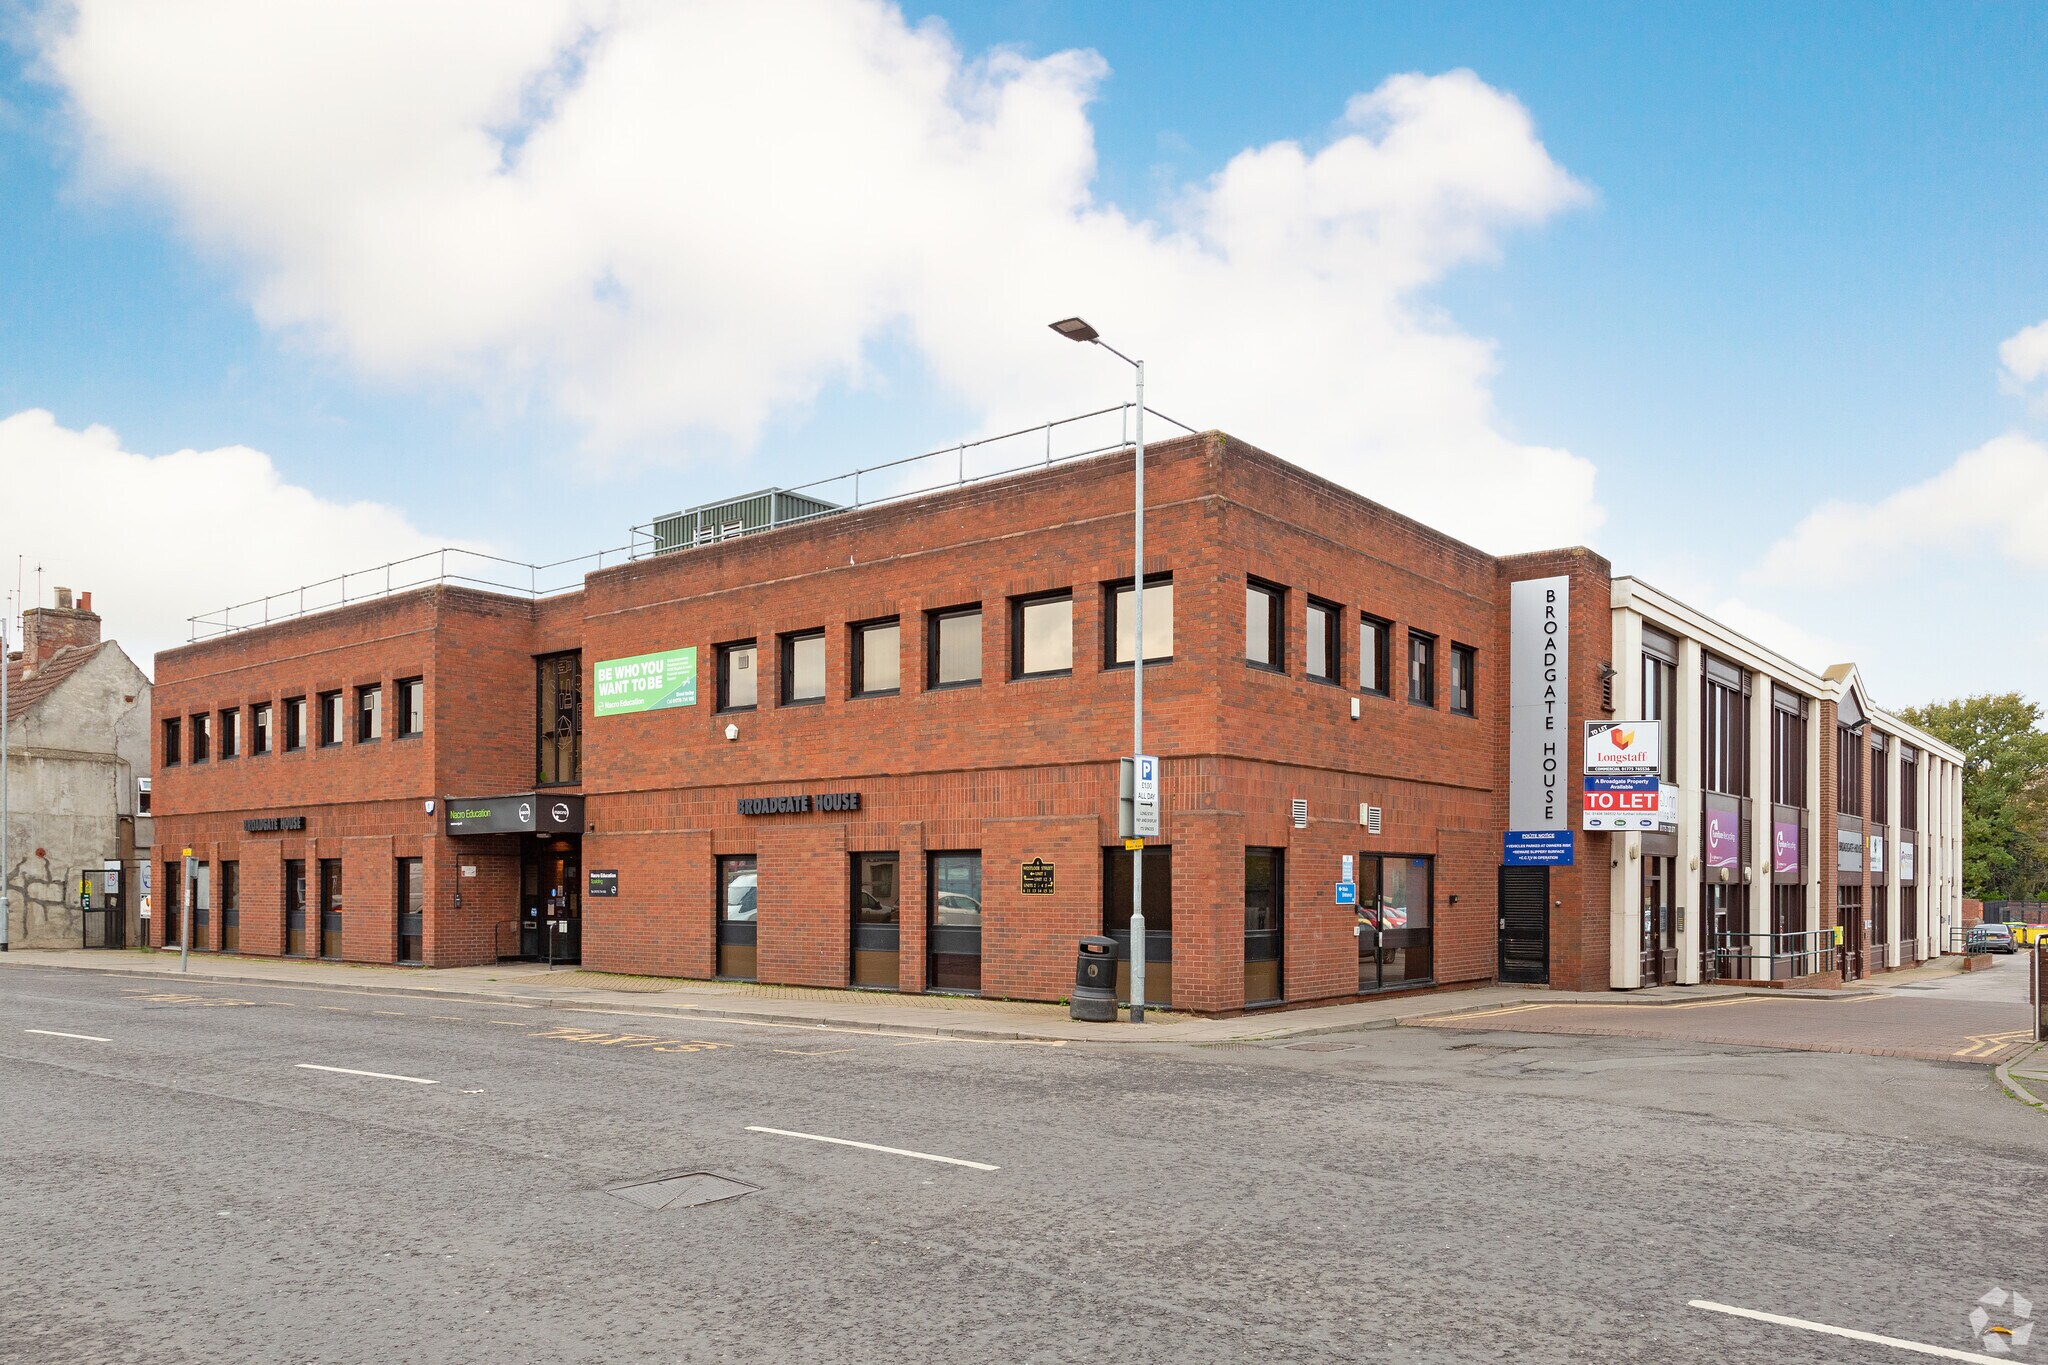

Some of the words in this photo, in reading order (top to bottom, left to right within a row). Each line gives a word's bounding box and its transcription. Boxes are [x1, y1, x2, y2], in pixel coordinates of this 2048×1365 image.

[1544, 590, 1558, 730] BROADGATE
[598, 668, 612, 682] BE
[614, 664, 639, 679] WHO
[641, 660, 664, 675] YOU
[598, 680, 629, 696] WANT
[631, 678, 646, 692] TO
[647, 675, 662, 690] BE
[605, 701, 619, 709] Nacro
[619, 698, 645, 708] Education
[1590, 728, 1598, 736] TO
[1598, 724, 1608, 733] LET
[1597, 752, 1647, 764] Longstaff
[1543, 742, 1557, 819] HOUSE
[1138, 792, 1146, 800] ALL
[1586, 793, 1614, 808] TO
[1619, 793, 1656, 808] LET
[737, 795, 809, 815] BROADGATE
[814, 793, 858, 812] HOUSE
[450, 811, 465, 819] Nacro
[466, 808, 491, 819] Education
[244, 818, 278, 831] BROADGATE
[280, 817, 301, 830] HOUSE
